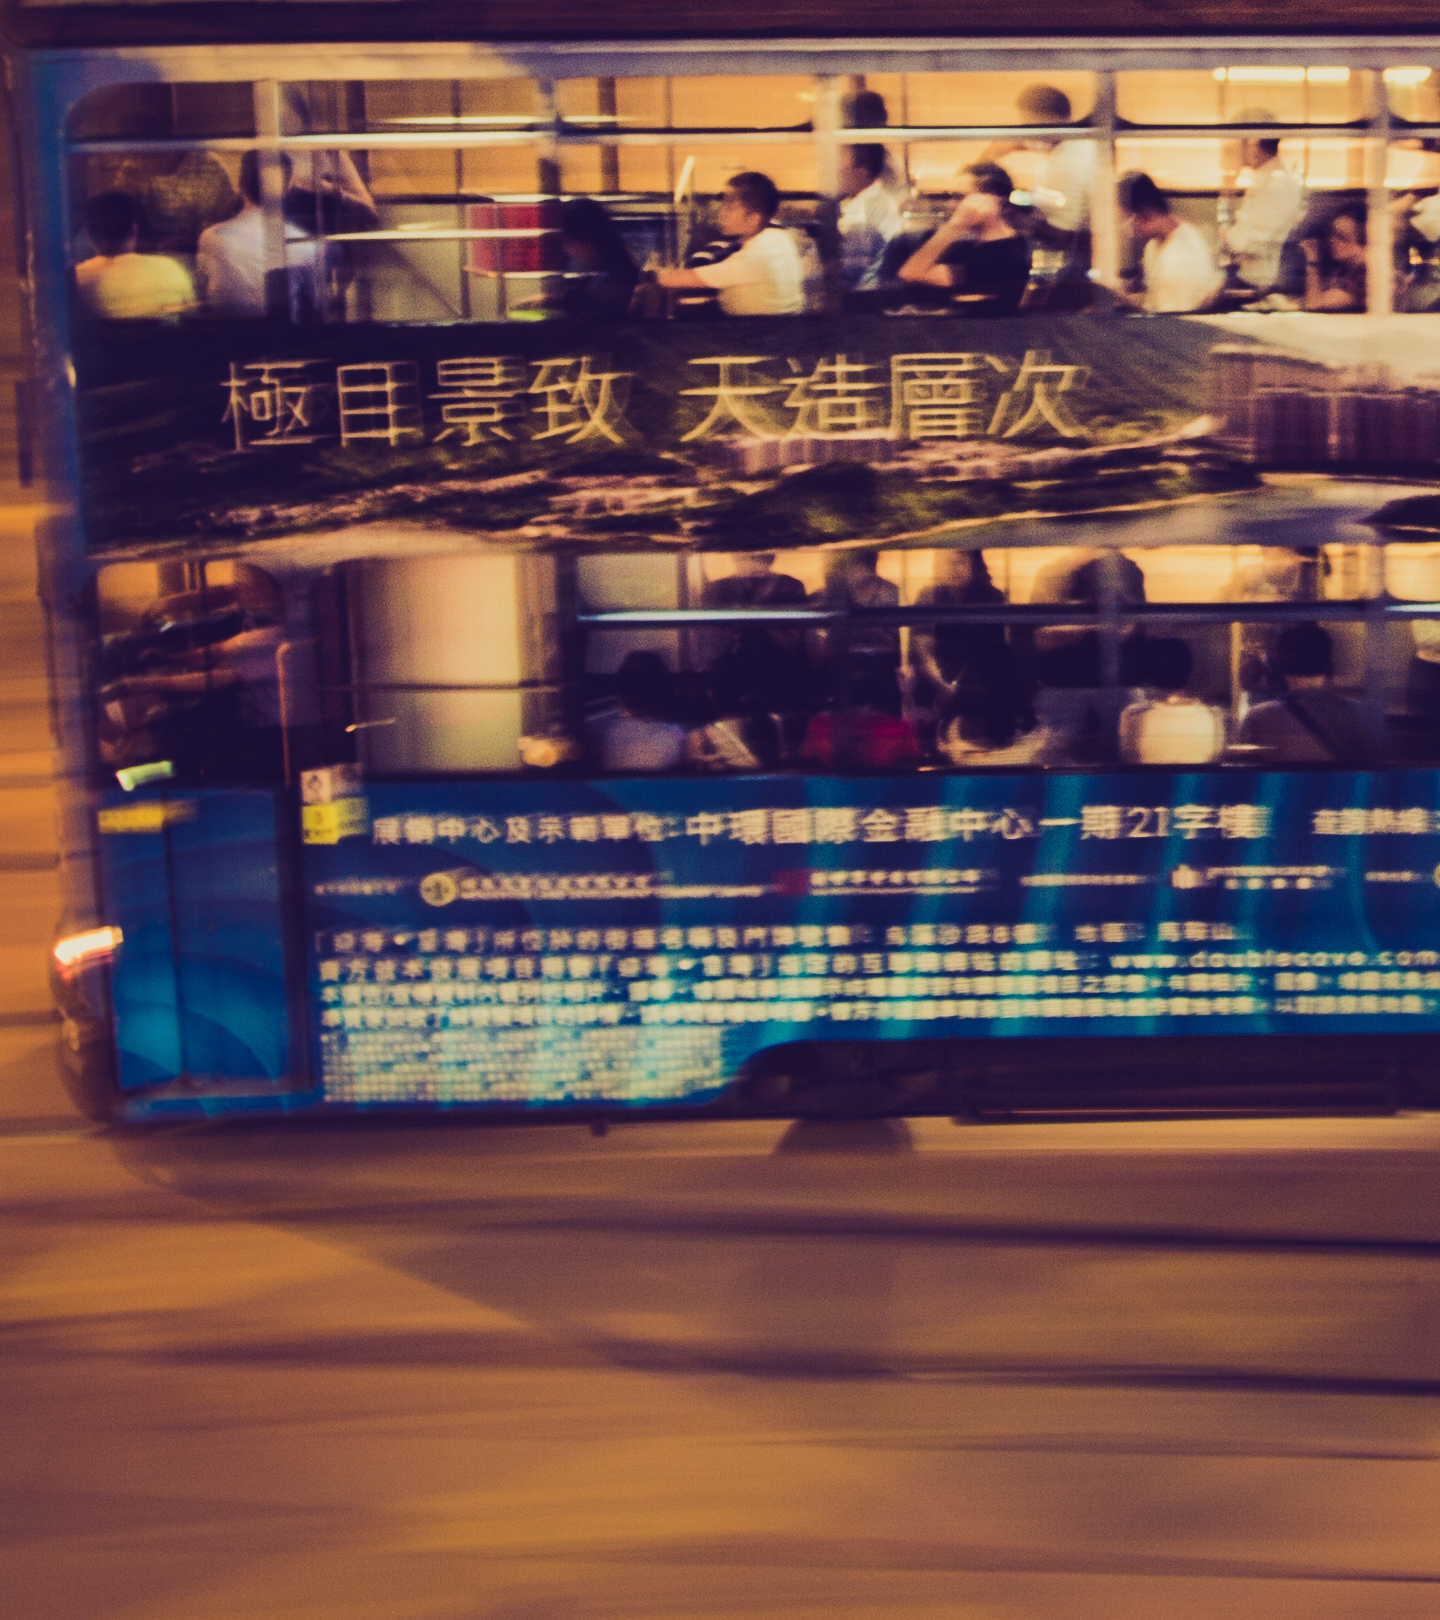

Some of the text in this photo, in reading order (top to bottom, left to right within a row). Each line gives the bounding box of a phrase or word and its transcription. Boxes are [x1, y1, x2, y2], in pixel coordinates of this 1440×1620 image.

[220, 349, 1090, 451] 極目景致 天造層次
